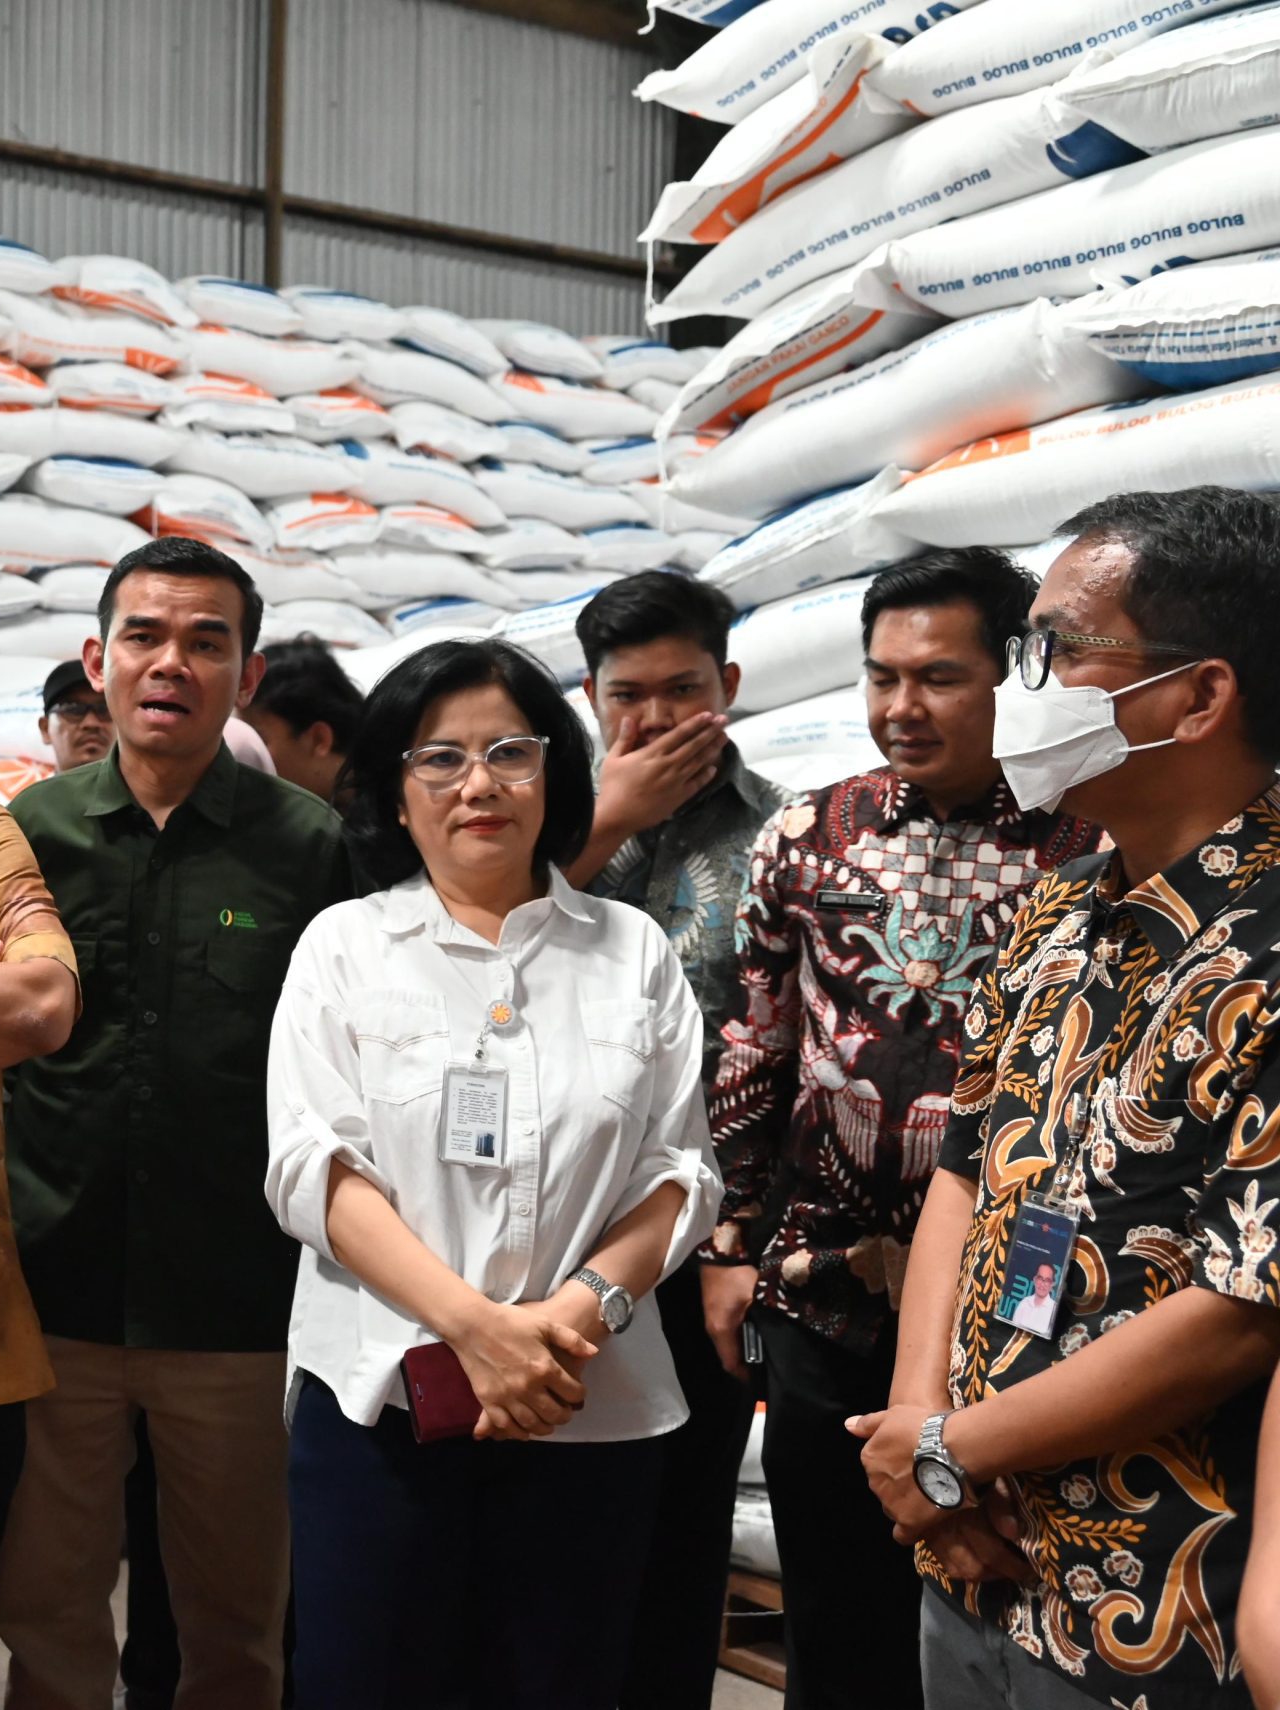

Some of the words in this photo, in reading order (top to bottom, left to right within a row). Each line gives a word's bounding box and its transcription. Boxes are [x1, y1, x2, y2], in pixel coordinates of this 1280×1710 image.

[840, 0, 886, 26] BULOG
[1141, 0, 1194, 29] BULOG
[798, 21, 838, 52] BULOG
[1086, 20, 1138, 49] BULOG
[760, 49, 798, 82] BULOG
[1032, 42, 1083, 67] BULOG
[982, 58, 1030, 81] BULOG
[716, 79, 757, 107] BULOG
[932, 75, 977, 98] BULOG
[943, 168, 991, 197] BULOG
[897, 191, 941, 216] BULOG
[850, 211, 896, 236] BULOG
[1187, 213, 1246, 235] BULOG
[807, 229, 849, 255] BULOG
[1130, 225, 1183, 250] BULOG
[765, 249, 807, 280] BULOG
[1023, 255, 1072, 276] BULOG
[1076, 241, 1126, 265] BULOG
[918, 279, 966, 296] BULOG
[972, 266, 1020, 287] BULOG
[721, 277, 762, 306] BULOG
[1097, 413, 1151, 435] BULOG
[1157, 399, 1214, 421] BULOG
